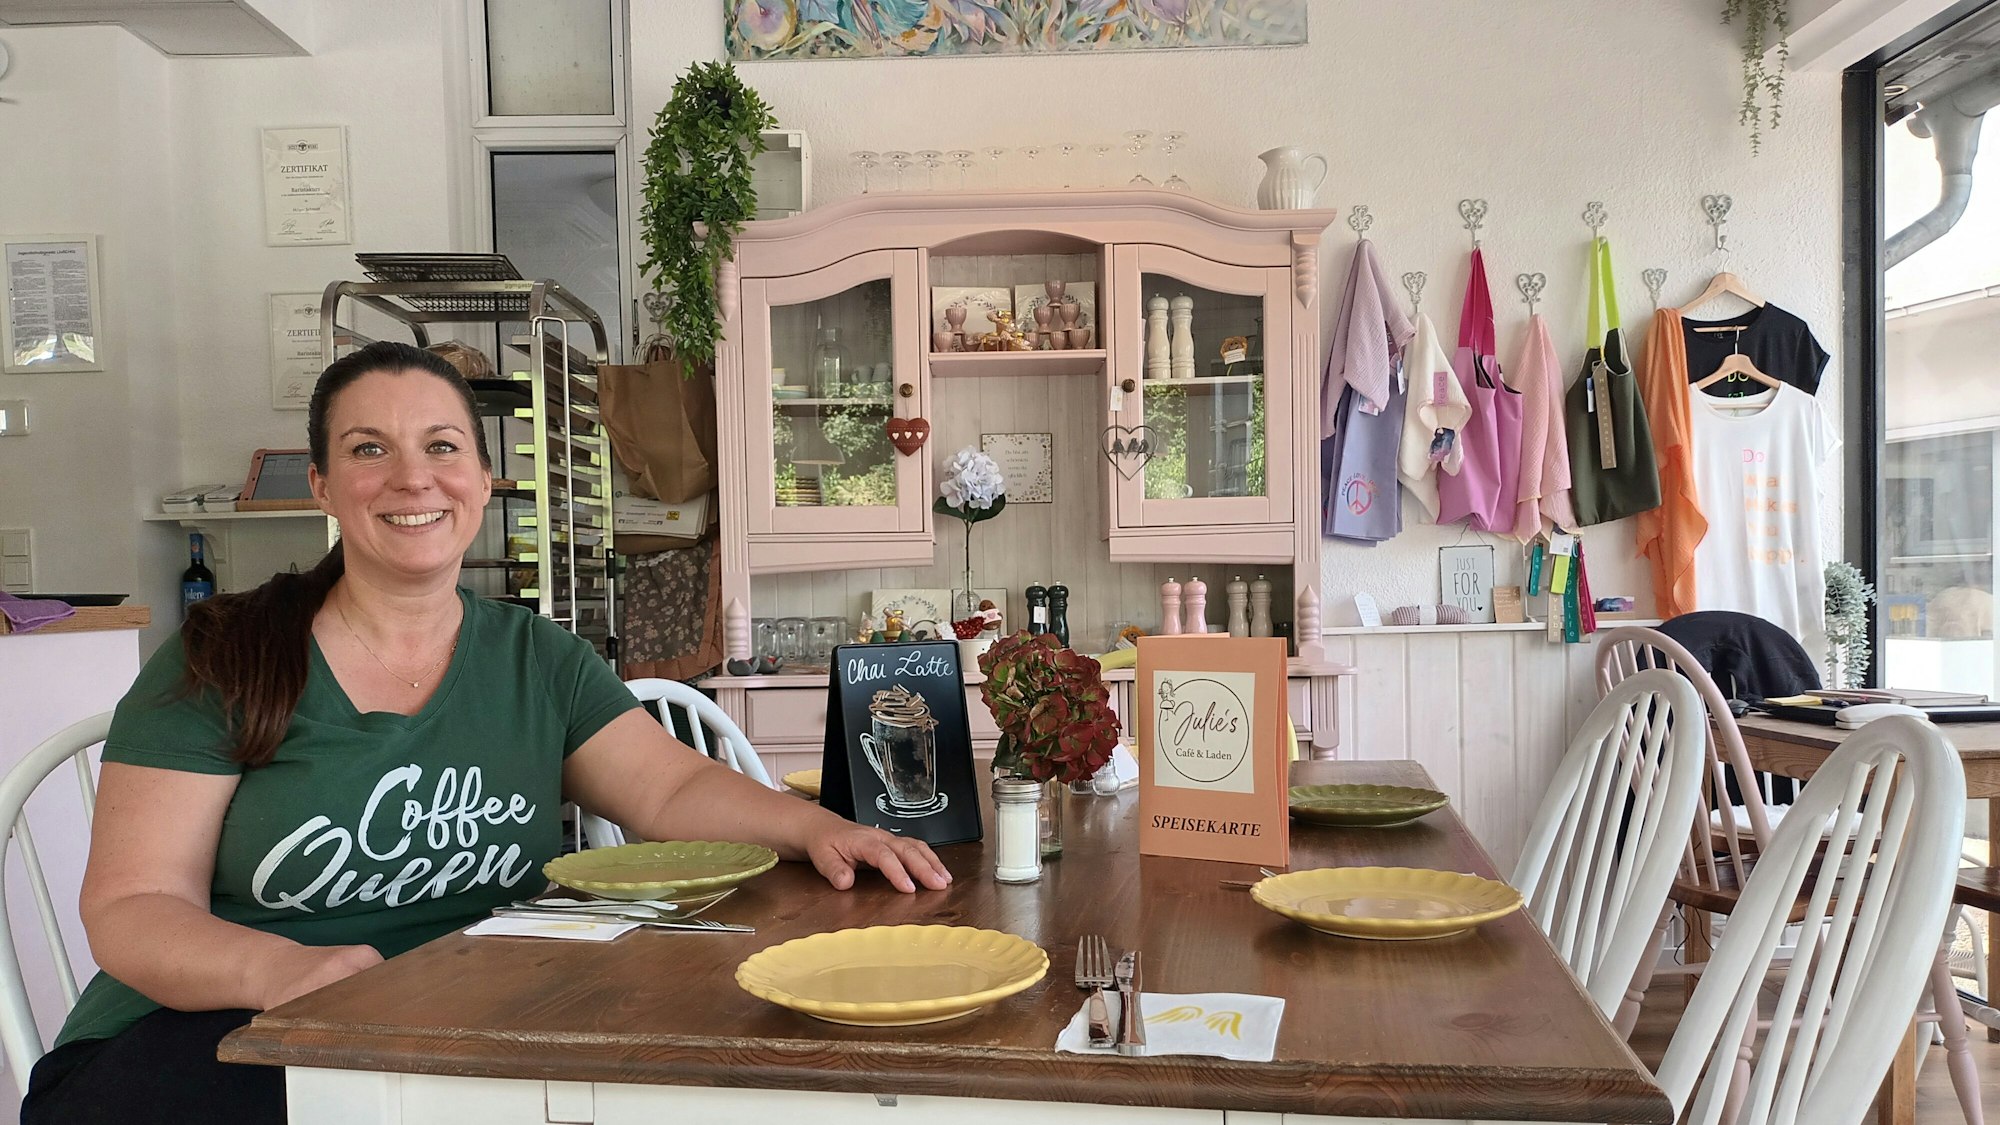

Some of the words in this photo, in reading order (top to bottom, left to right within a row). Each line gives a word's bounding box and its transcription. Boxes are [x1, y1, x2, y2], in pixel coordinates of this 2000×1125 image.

[280, 164, 328, 173] ZERTIFIKAT
[287, 329, 322, 337] ZERTIFI
[1743, 449, 1765, 463] Do
[1456, 557, 1475, 571] JUST
[1453, 572, 1480, 595] FOR
[1456, 596, 1477, 612] YOU
[847, 653, 887, 685] Chai
[894, 650, 953, 677] Latte
[1173, 700, 1238, 746] Julie's
[1175, 747, 1195, 758] Café
[1196, 749, 1204, 759] &
[1205, 750, 1232, 760] Laden
[358, 763, 536, 861] Coffee
[1151, 814, 1261, 837] SPEISEKARTE
[251, 815, 532, 913] Queen
